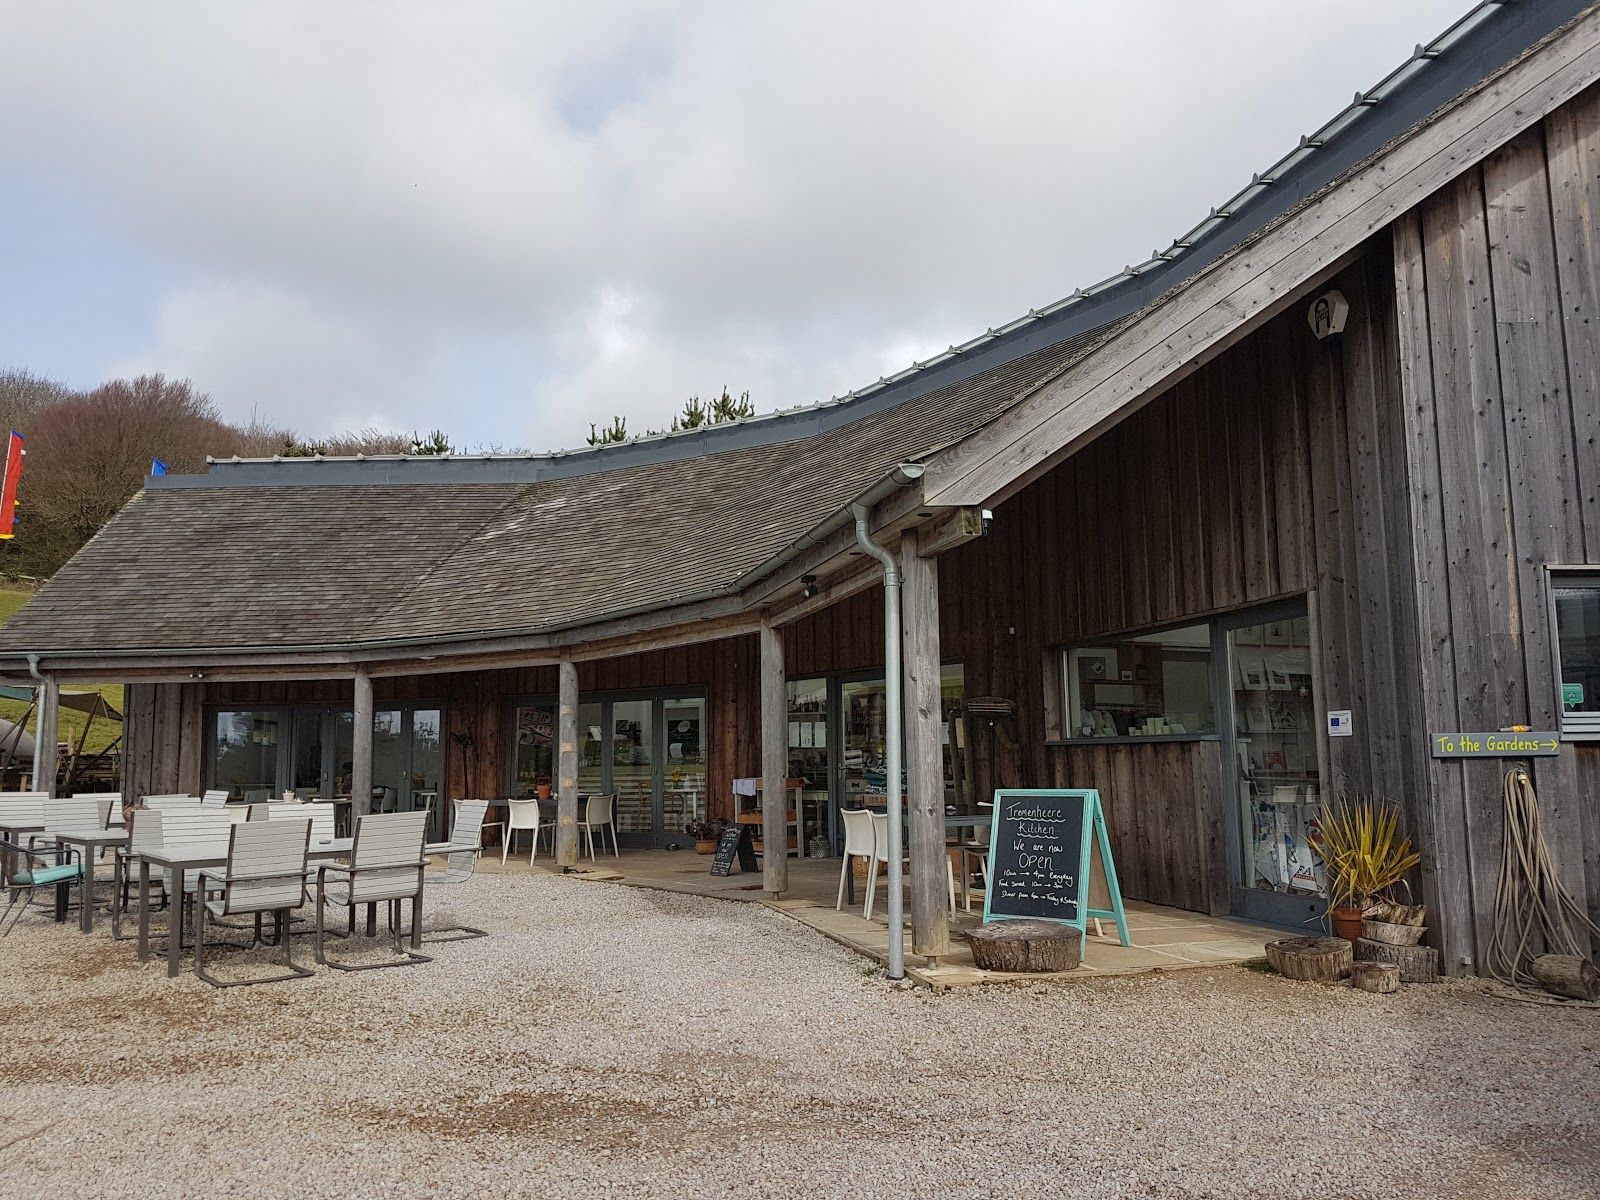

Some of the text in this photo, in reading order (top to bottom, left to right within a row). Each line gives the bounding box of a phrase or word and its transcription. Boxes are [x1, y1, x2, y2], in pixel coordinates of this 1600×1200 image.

[1436, 735, 1539, 753] To the Gardens
[1018, 821, 1055, 835] Kitchen
[1013, 838, 1025, 851] We
[1048, 845, 1063, 853] now
